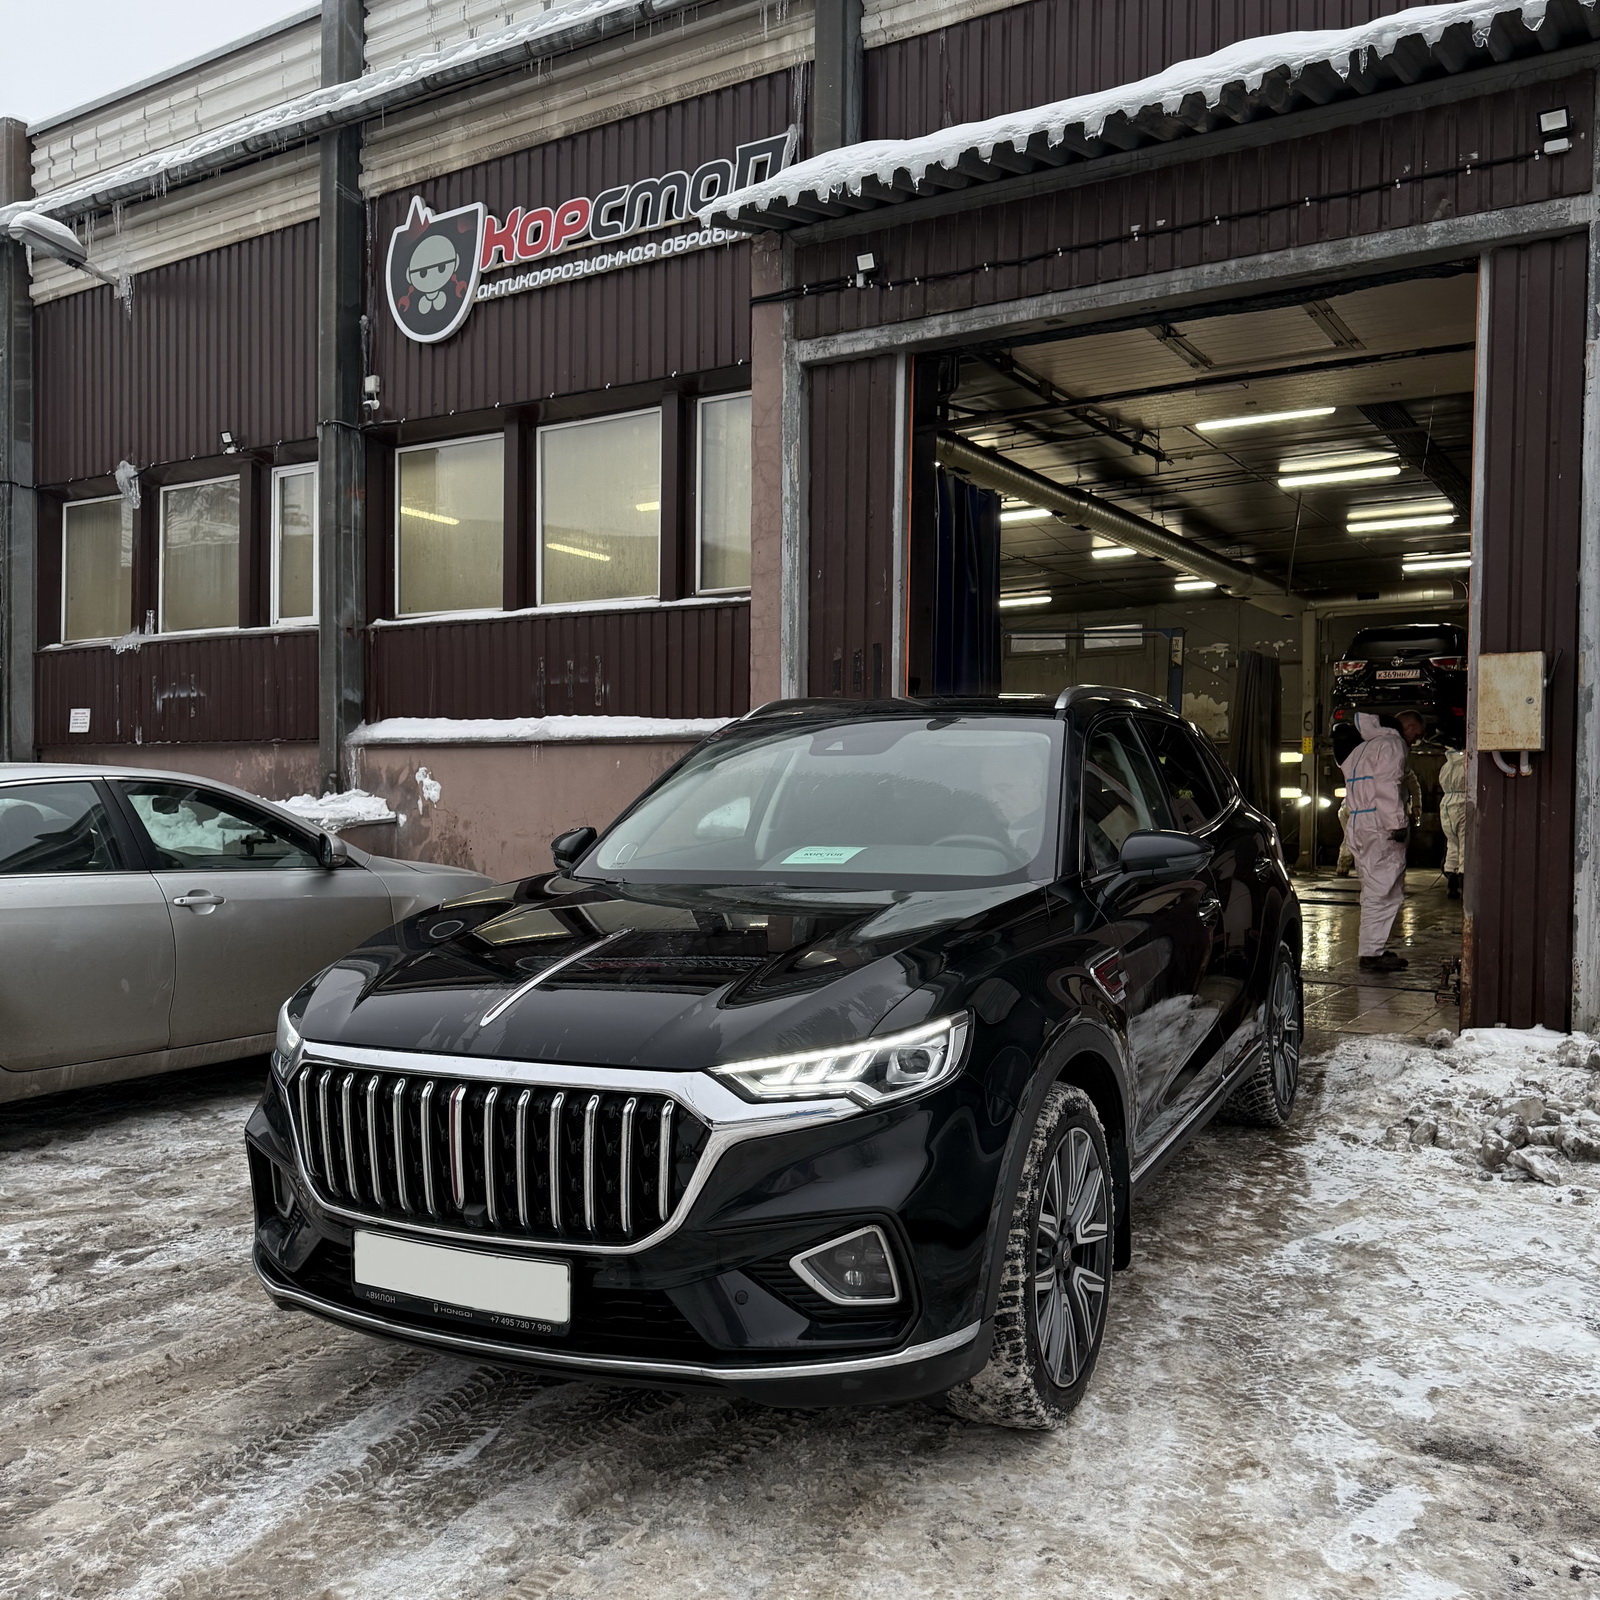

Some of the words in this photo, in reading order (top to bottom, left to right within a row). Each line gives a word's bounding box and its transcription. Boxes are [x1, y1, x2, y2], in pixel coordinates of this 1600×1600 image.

[365, 1290, 396, 1303] АВИЛОН
[440, 1307, 473, 1317] HONGQI
[490, 1315, 500, 1324] +7
[500, 1317, 515, 1327] 495
[515, 1319, 530, 1329] 730
[537, 1323, 552, 1333] 999
